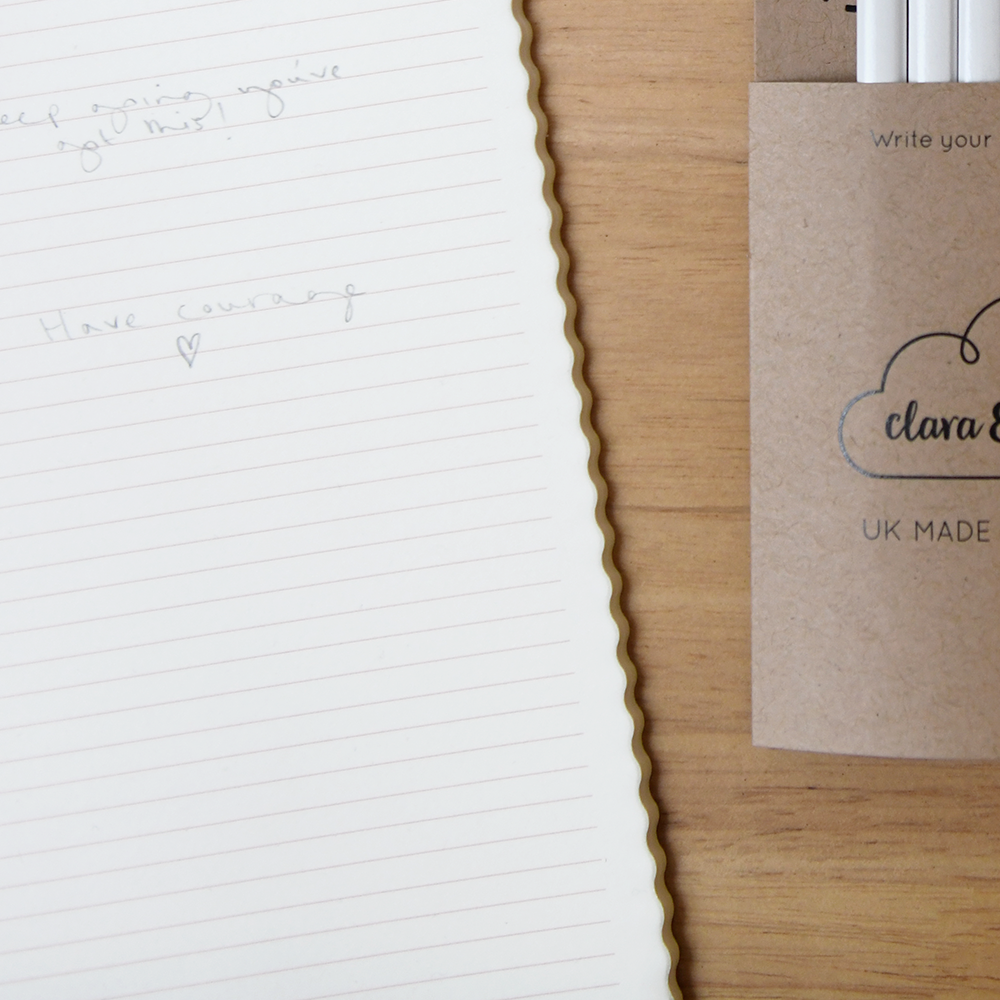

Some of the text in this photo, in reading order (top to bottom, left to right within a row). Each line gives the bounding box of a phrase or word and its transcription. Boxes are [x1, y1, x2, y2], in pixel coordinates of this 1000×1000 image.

[0, 103, 60, 128] eep
[870, 129, 932, 149] Write
[940, 133, 992, 153] your
[39, 308, 143, 342] Have
[885, 400, 985, 442] clara
[862, 518, 902, 542] UK
[914, 519, 991, 543] MADE
